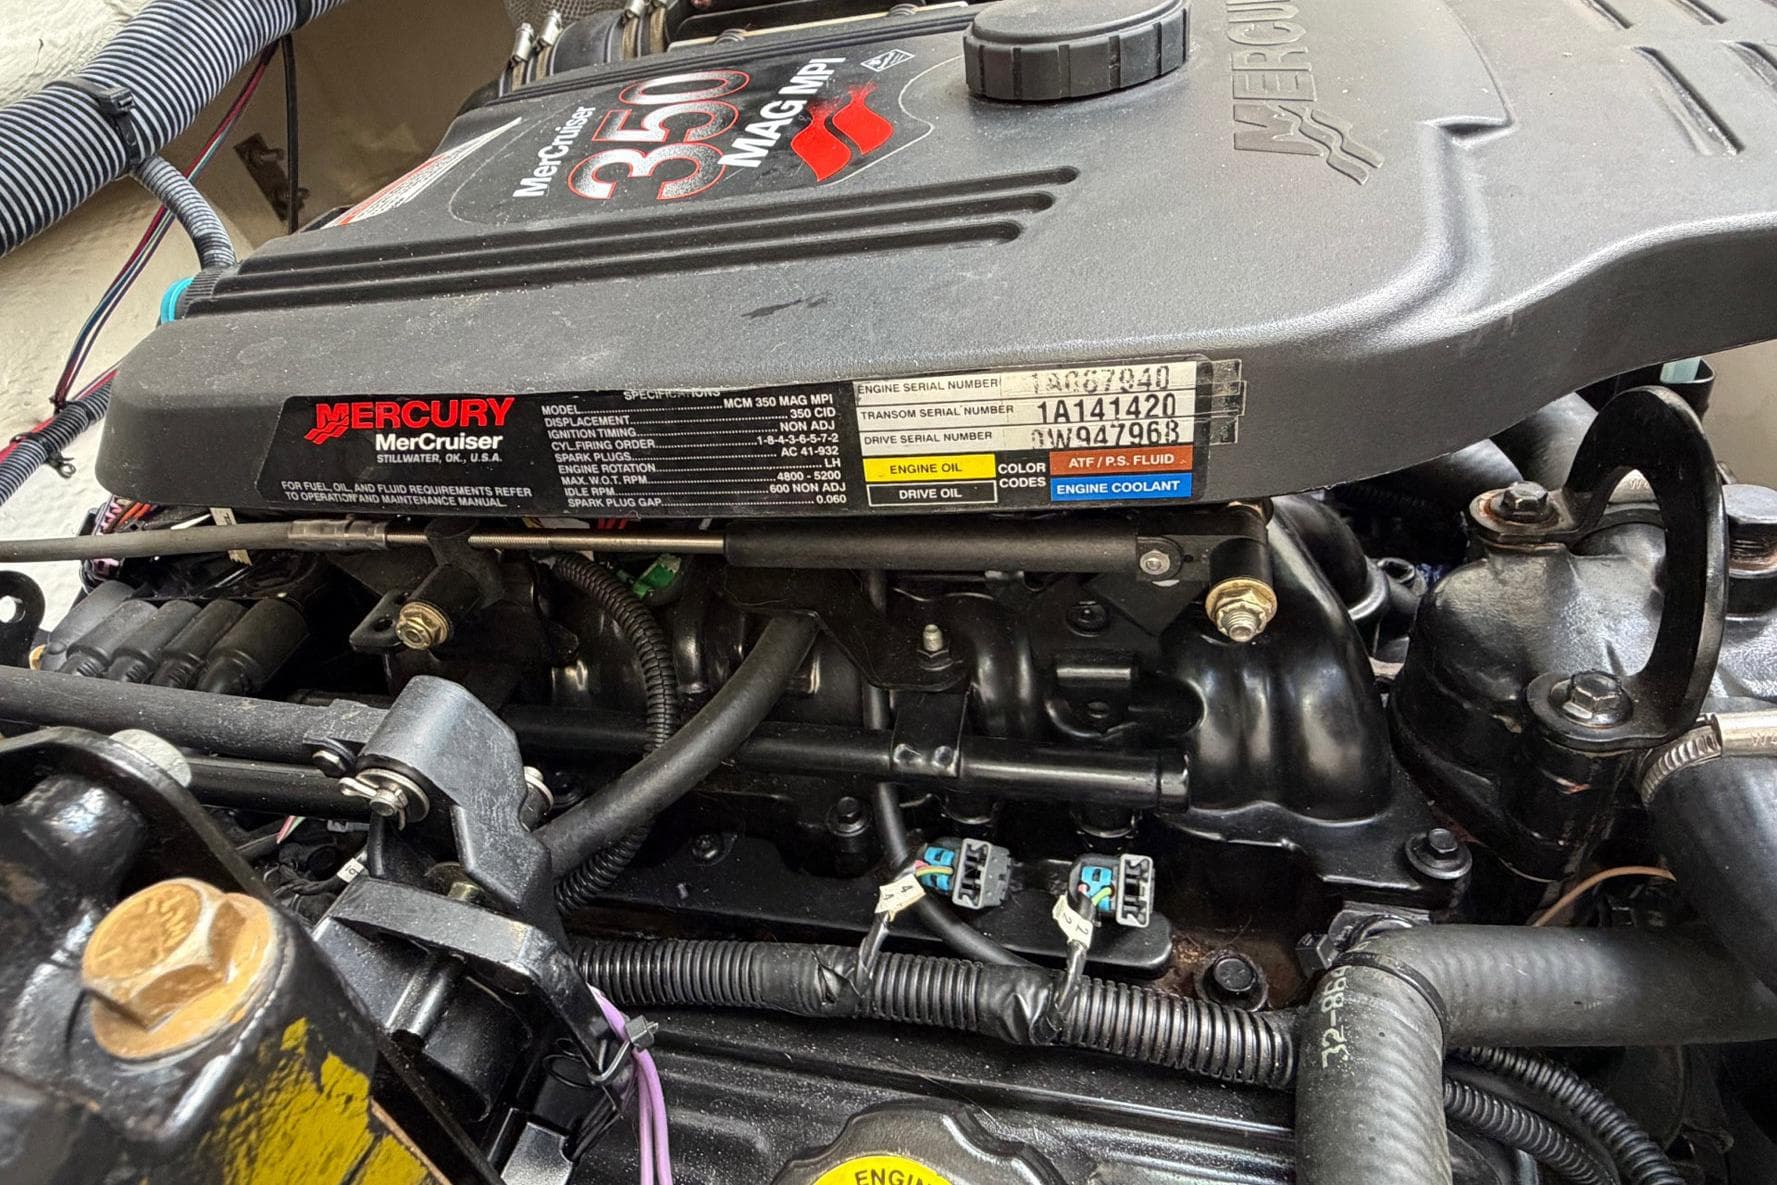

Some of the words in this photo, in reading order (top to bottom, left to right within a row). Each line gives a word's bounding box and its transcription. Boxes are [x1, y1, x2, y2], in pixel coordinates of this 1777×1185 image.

[717, 101, 807, 168] MAG
[778, 57, 846, 98] MPI
[568, 69, 750, 200] 350
[512, 106, 596, 197] MerCruiser
[857, 383, 900, 394] ENGINE
[903, 380, 945, 392] SERIAL
[948, 378, 998, 390] NUMBER
[541, 405, 579, 415] MODEL
[723, 397, 753, 408] MCM
[755, 396, 776, 407] 350
[779, 395, 808, 406] MAG
[810, 393, 833, 405] MPI
[861, 409, 916, 420] TRANSOM
[920, 407, 960, 418] SERIAL
[964, 404, 1014, 416] NUMBER
[1037, 392, 1176, 425] 1A141420
[304, 397, 515, 445] MERCURY
[544, 415, 630, 427] DISPLACEMENT
[790, 408, 811, 419] 350
[814, 407, 836, 418] CID
[547, 429, 596, 439] IGNITION
[597, 428, 636, 438] TIMING
[780, 421, 808, 432] NON
[811, 420, 835, 431] ADJ
[375, 432, 503, 451] MerCruiser
[615, 439, 655, 449] ORDER
[756, 433, 839, 445] 1-8-4-3-6-5-7-2
[864, 435, 897, 445] DRIVE
[900, 433, 940, 444] SERIAL
[943, 431, 993, 442] NUMBER
[376, 453, 442, 464] STILLWATER,
[470, 452, 503, 463] U.S.A.
[554, 452, 592, 462] SPARK
[593, 452, 631, 461] PLUGS
[781, 447, 798, 457] AC
[800, 446, 839, 456] 41-932
[1068, 457, 1095, 468] ATF
[1105, 456, 1130, 467] P.S.
[1133, 453, 1174, 465] FLUID
[558, 464, 599, 474] ENGINE
[601, 463, 656, 473] ROTATION
[824, 458, 841, 468] LH
[890, 465, 938, 475] ENGINE
[941, 463, 962, 473] OIL
[998, 462, 1047, 474] COLOR
[622, 475, 647, 484] RPM
[777, 471, 804, 481] 4800
[813, 470, 841, 480] 5200
[999, 476, 1047, 488] CODES
[281, 481, 302, 490] FOR
[354, 483, 376, 493] AND
[377, 484, 407, 494] FLUID
[408, 485, 493, 496] REQUIREMENTS
[494, 487, 533, 497] REFER
[564, 487, 589, 496] IDLE
[591, 487, 616, 496] RPM
[769, 484, 790, 493] 600
[792, 483, 819, 493] NON
[822, 482, 847, 492] ADJ
[899, 488, 938, 500] DRIVE
[940, 487, 962, 498] OIL
[1056, 482, 1108, 495] ENGINE
[1112, 480, 1180, 493] COOLANT
[285, 491, 299, 501] TO
[300, 492, 357, 502] OPERATION
[357, 494, 380, 503] AND
[381, 495, 457, 506] MAINTENANCE
[568, 498, 604, 507] SPARK
[606, 498, 636, 507] PLUG
[638, 498, 662, 507] GAP
[816, 495, 847, 504] 0.060
